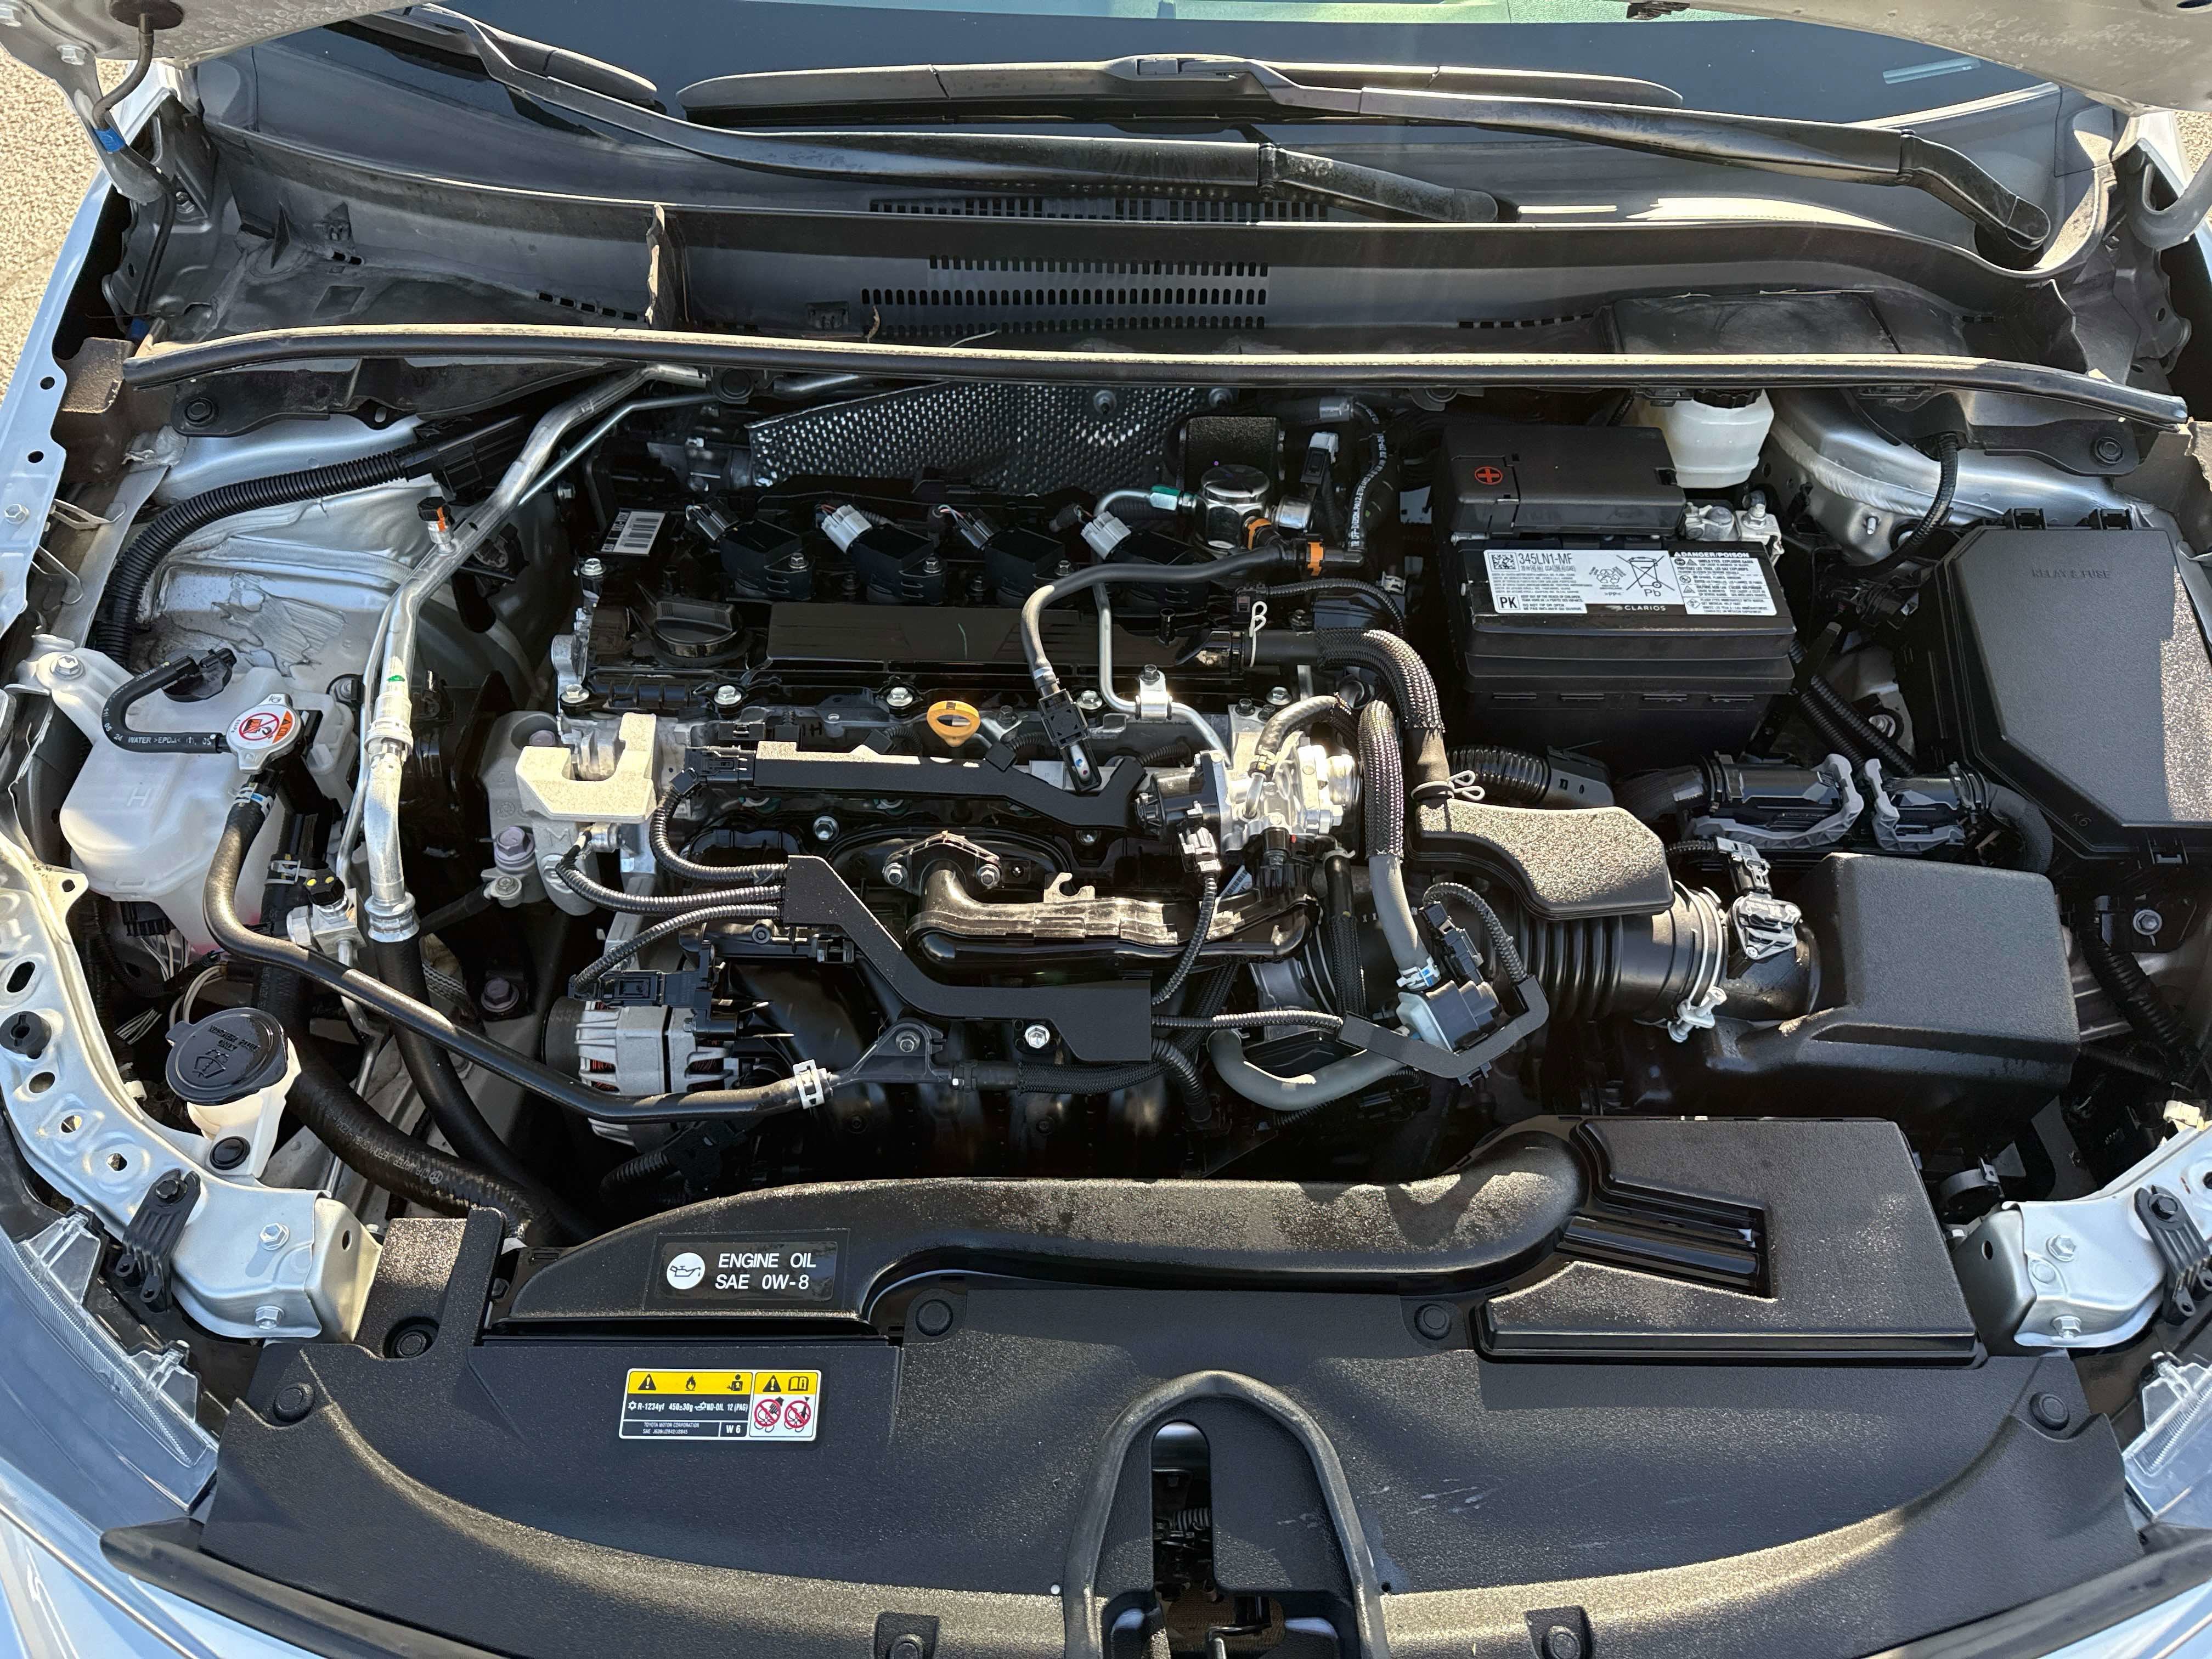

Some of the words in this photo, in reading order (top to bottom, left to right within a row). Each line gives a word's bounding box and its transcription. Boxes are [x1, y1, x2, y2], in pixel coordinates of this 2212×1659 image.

[1518, 552, 1573, 565] 345LN1-MF
[1644, 589, 1661, 597] Pb
[1499, 596, 1517, 608] PK
[718, 1252, 780, 1268] ENGINE
[790, 1252, 816, 1268] OIL
[715, 1274, 750, 1290] SAE
[761, 1274, 809, 1290] 0W-8
[637, 1402, 664, 1412] R-1234yf
[668, 1403, 693, 1413] 450±30g
[734, 1403, 748, 1413] (PAG)
[726, 1425, 735, 1434] W
[736, 1425, 741, 1434] 6
